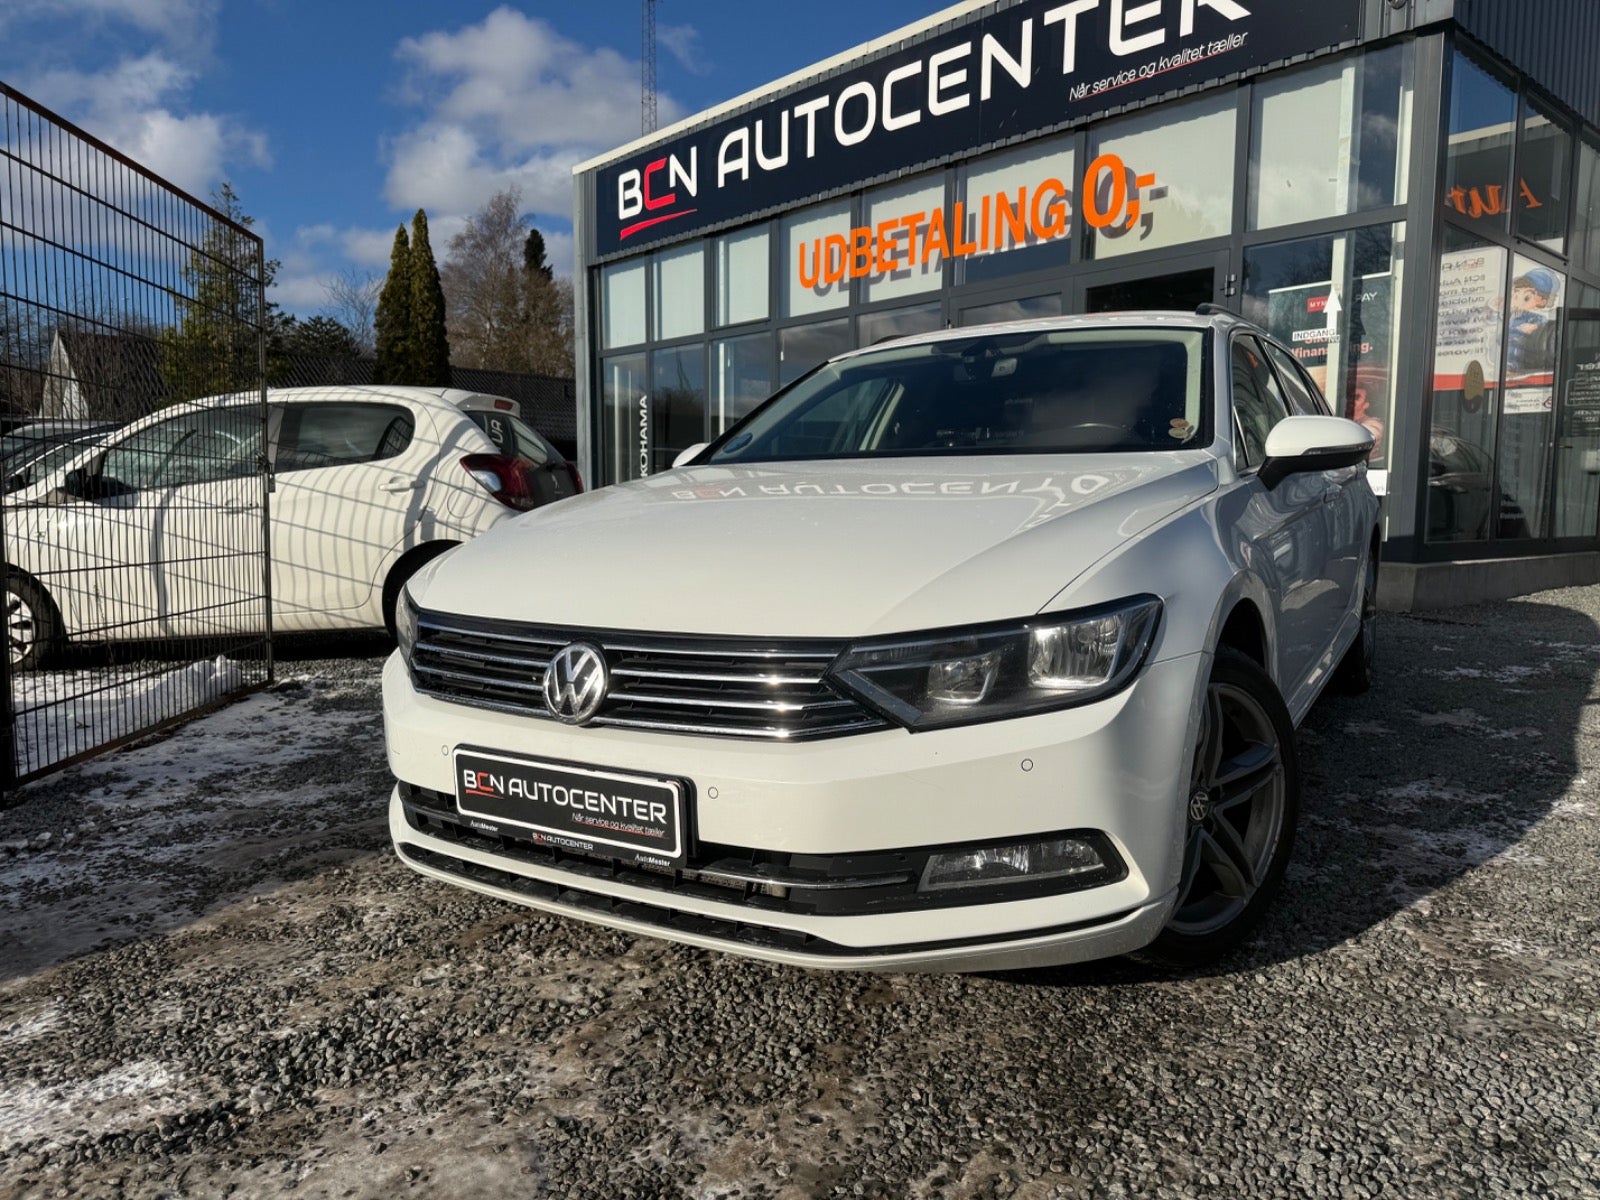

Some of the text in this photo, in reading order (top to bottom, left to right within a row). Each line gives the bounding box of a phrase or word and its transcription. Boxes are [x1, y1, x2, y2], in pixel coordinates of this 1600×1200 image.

[1069, 32, 1249, 102] Når service og kvalitet tæller
[618, 145, 698, 222] BCN
[799, 178, 1066, 289] UDBETALING
[1293, 328, 1336, 340] INDGANG
[463, 769, 668, 825] BCN AUTOCENTER
[547, 836, 594, 851] AUTOCENTER
